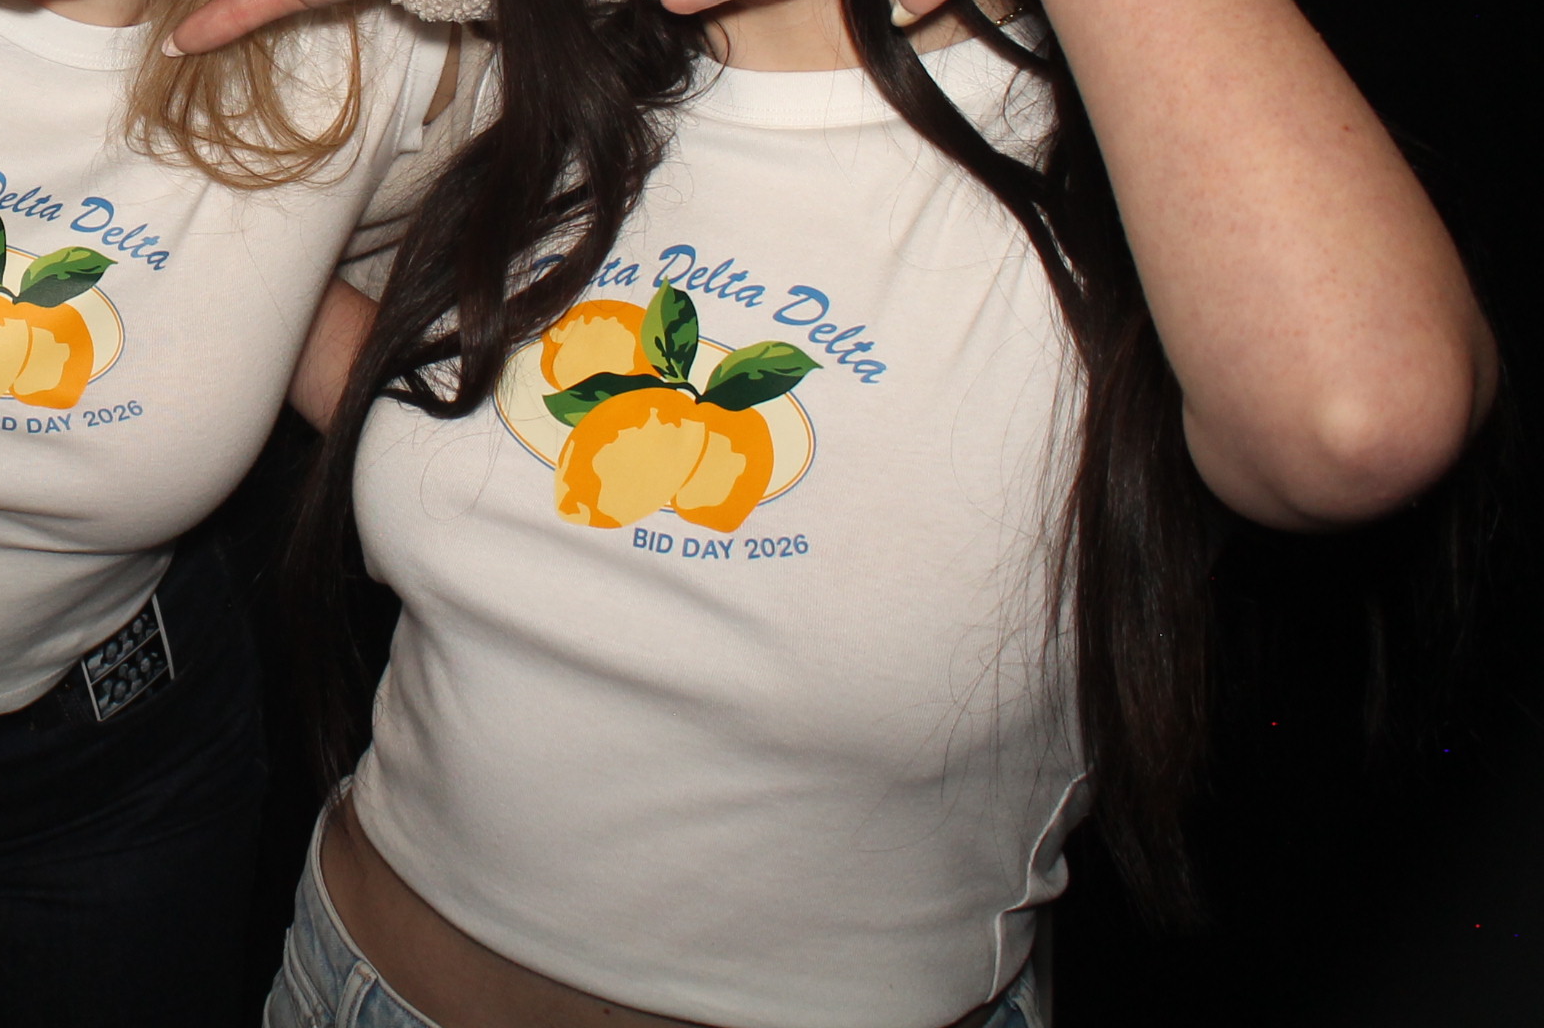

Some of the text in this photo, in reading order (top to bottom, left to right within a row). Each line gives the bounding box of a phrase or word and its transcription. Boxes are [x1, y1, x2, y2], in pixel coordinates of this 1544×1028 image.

[70, 196, 170, 271] Delta
[652, 244, 766, 306] Delta
[773, 285, 888, 384] Delta
[26, 413, 72, 434] DAY
[83, 400, 143, 428] 2026
[633, 527, 809, 559] BID DAY 2026
